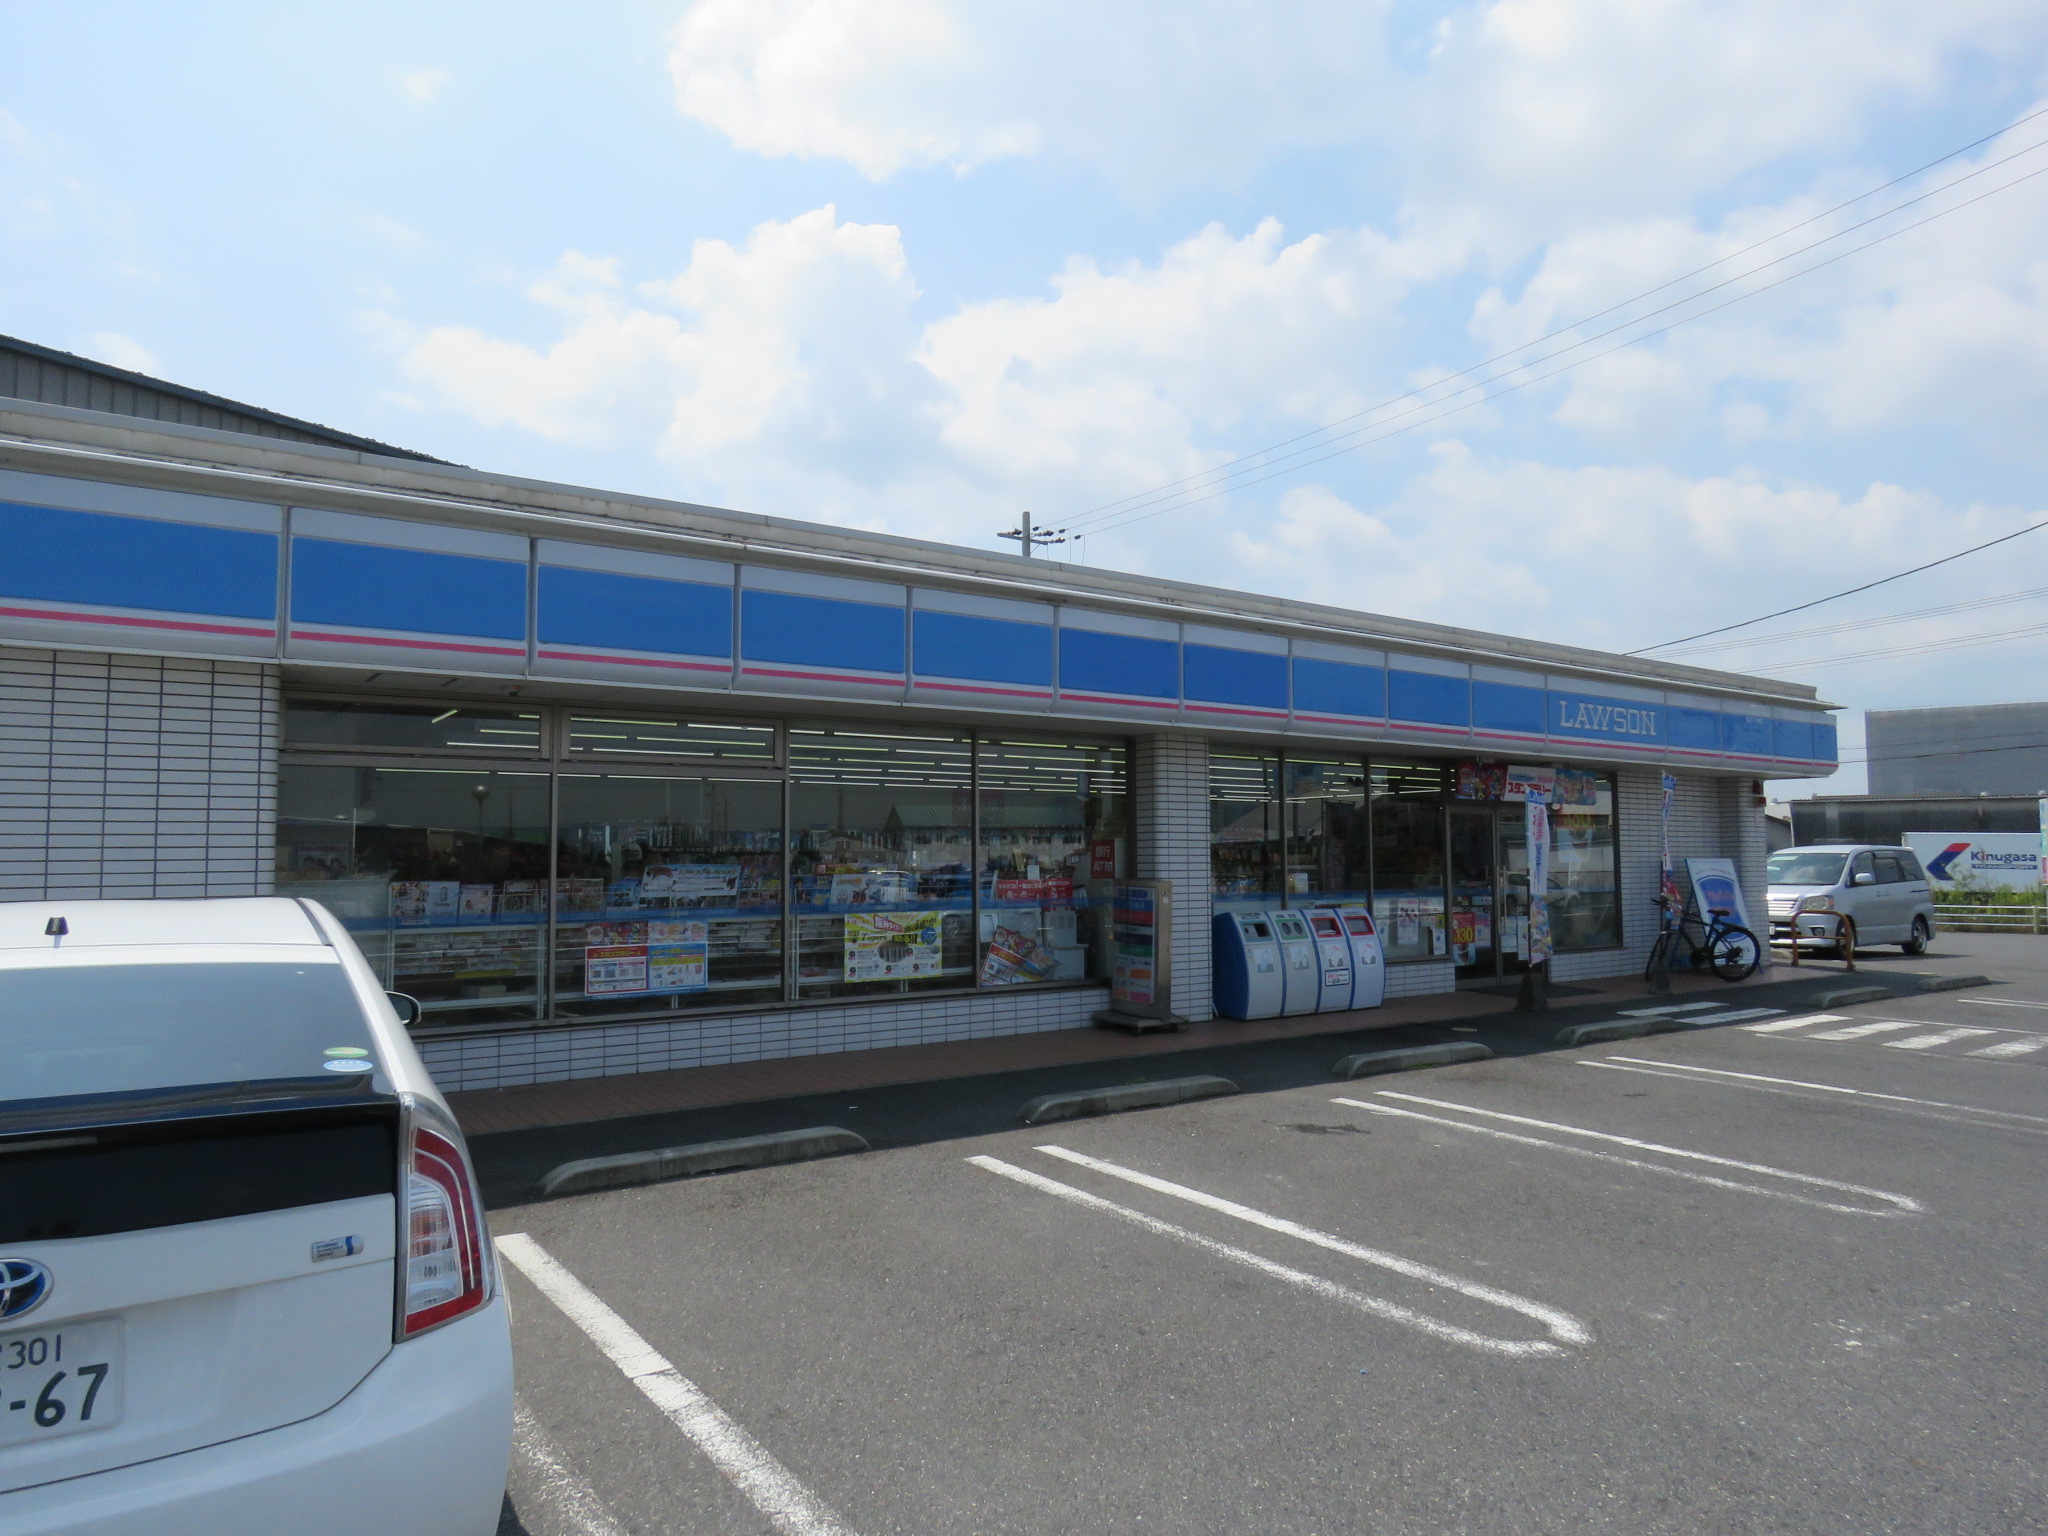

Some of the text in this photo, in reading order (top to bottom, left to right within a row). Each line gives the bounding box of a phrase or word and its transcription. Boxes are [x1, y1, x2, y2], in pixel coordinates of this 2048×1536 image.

[1560, 700, 1657, 736] LAWSON
[1507, 781, 1552, 795] スタンラリー
[1093, 861, 1113, 873] ATM
[1970, 851, 2037, 864] Kinugasa
[8, 1334, 62, 1369] 301
[0, 1363, 109, 1428] -67
